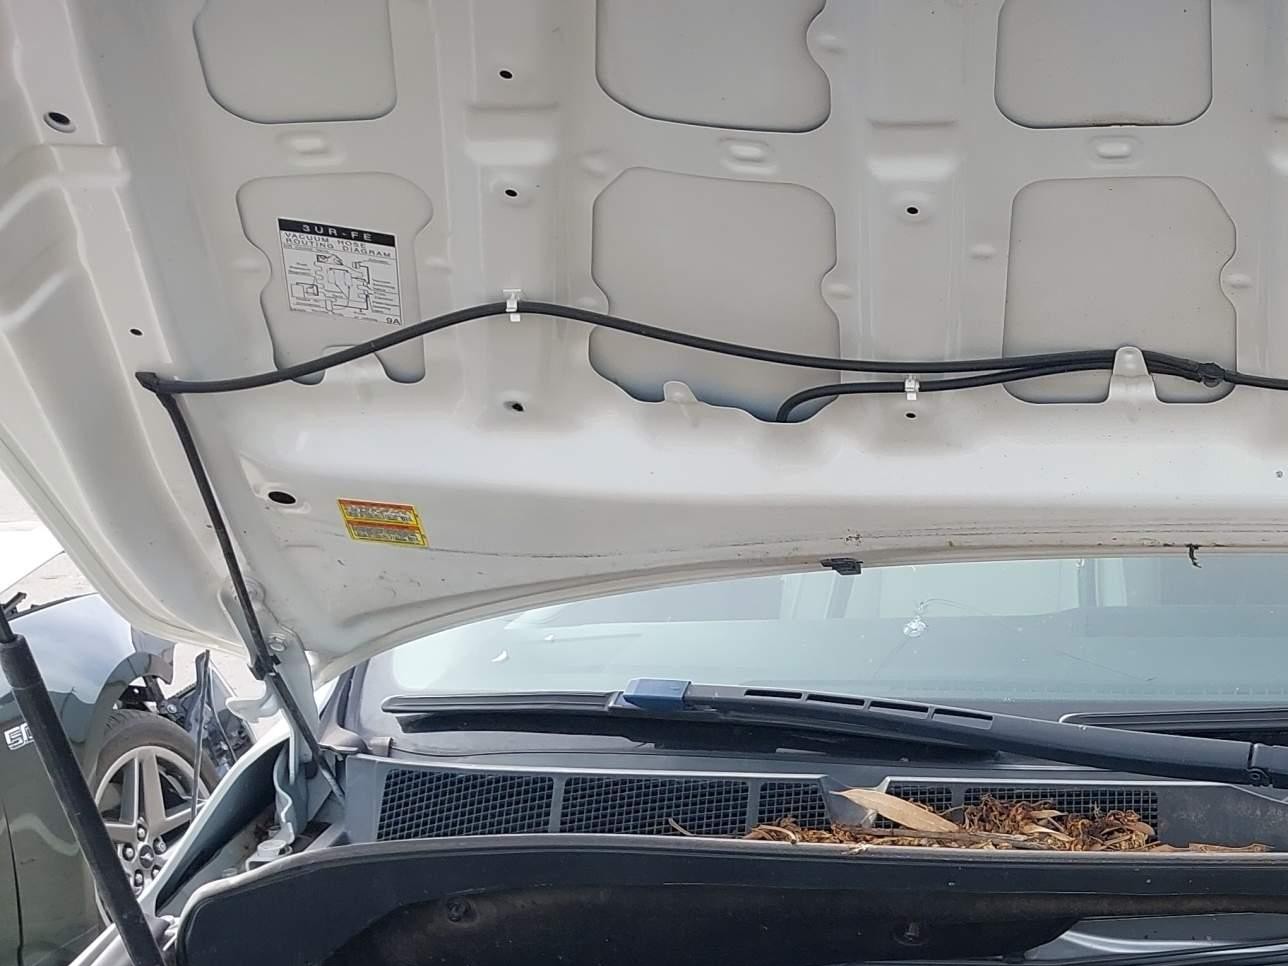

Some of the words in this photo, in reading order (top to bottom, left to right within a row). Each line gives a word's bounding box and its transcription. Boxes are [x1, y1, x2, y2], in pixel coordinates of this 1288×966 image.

[284, 231, 329, 243] VACUUM
[336, 239, 367, 249] HOSE
[302, 224, 373, 241] 3UR-FE
[285, 238, 335, 249] ROUTING
[342, 246, 391, 257] DIAGRAM
